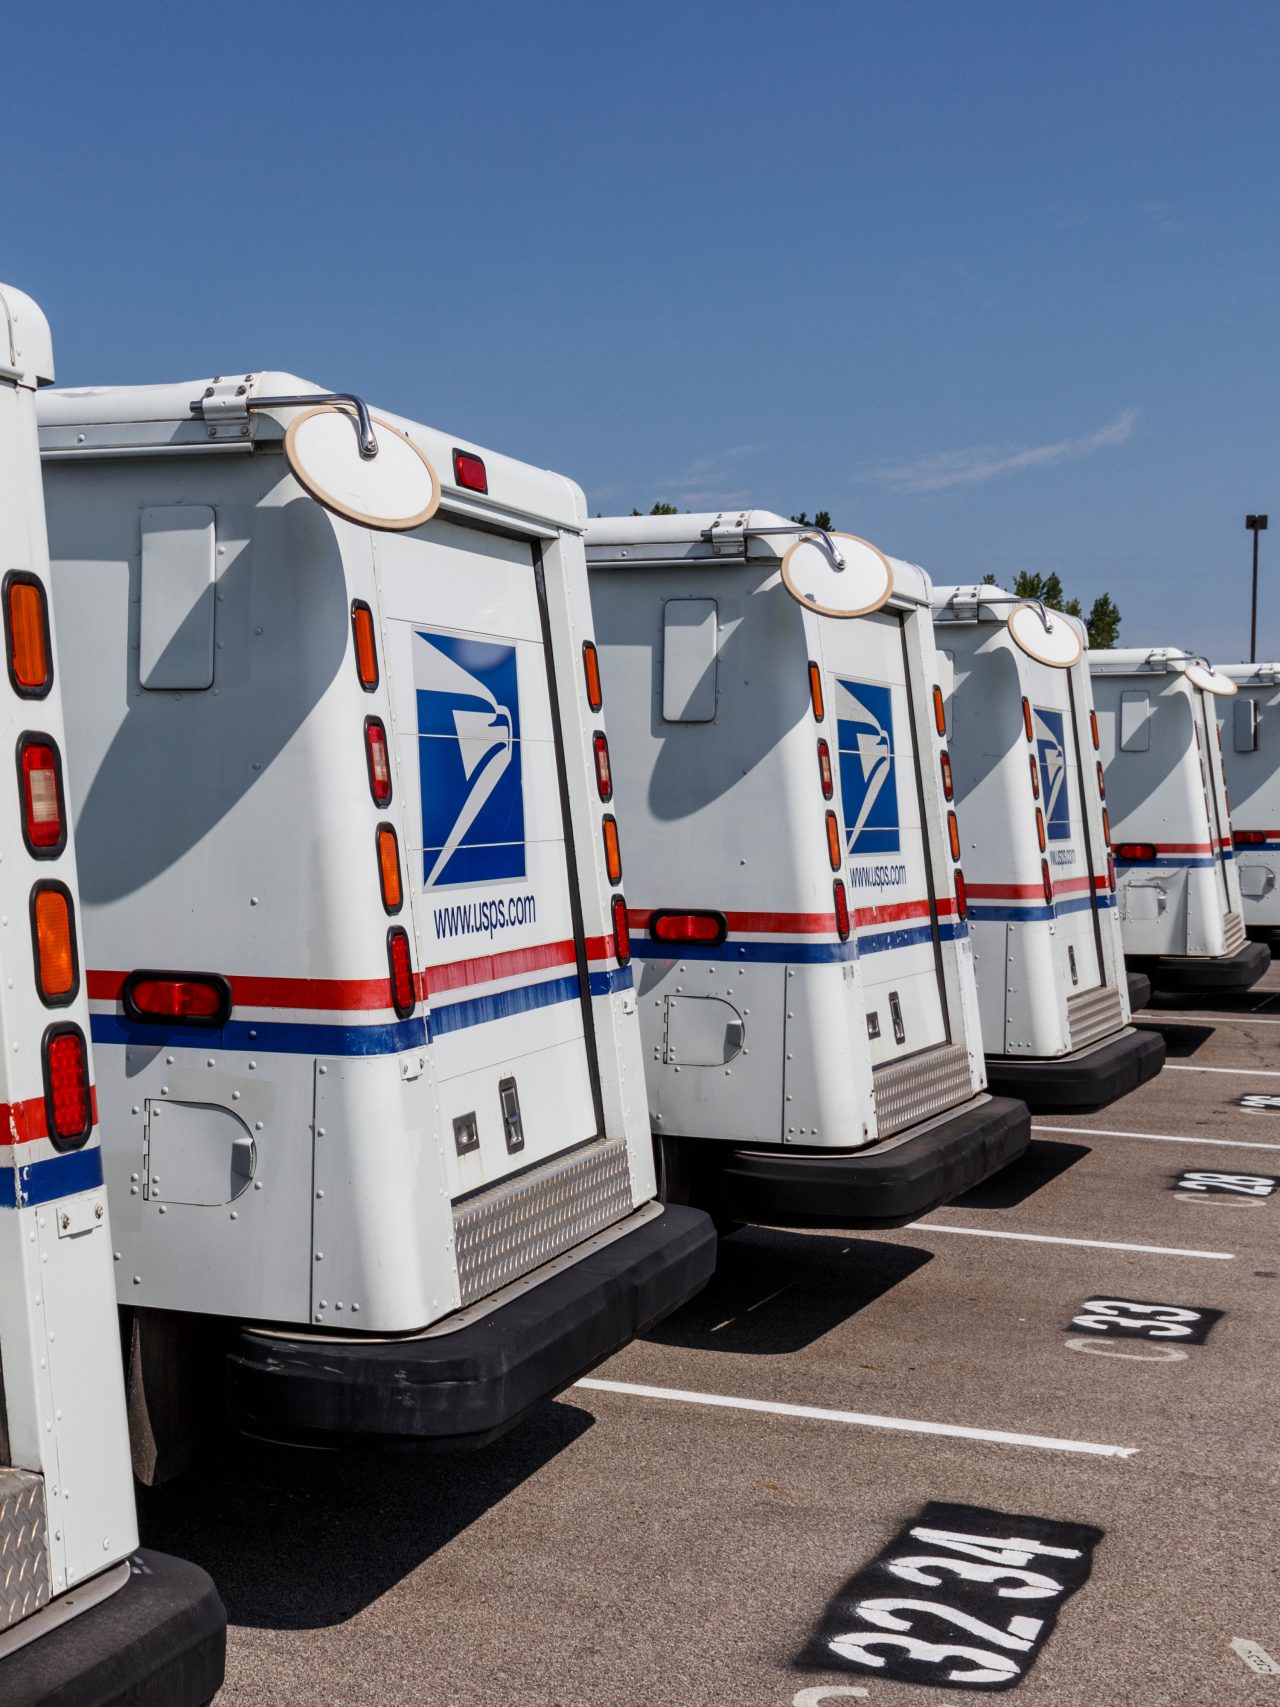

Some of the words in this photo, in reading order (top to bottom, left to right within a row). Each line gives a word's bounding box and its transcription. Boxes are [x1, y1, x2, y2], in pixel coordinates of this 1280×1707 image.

[849, 865, 907, 893] www.usps.com
[433, 895, 536, 939] www.usps.com
[1178, 1172, 1275, 1195] 28
[1072, 1300, 1202, 1336] 33
